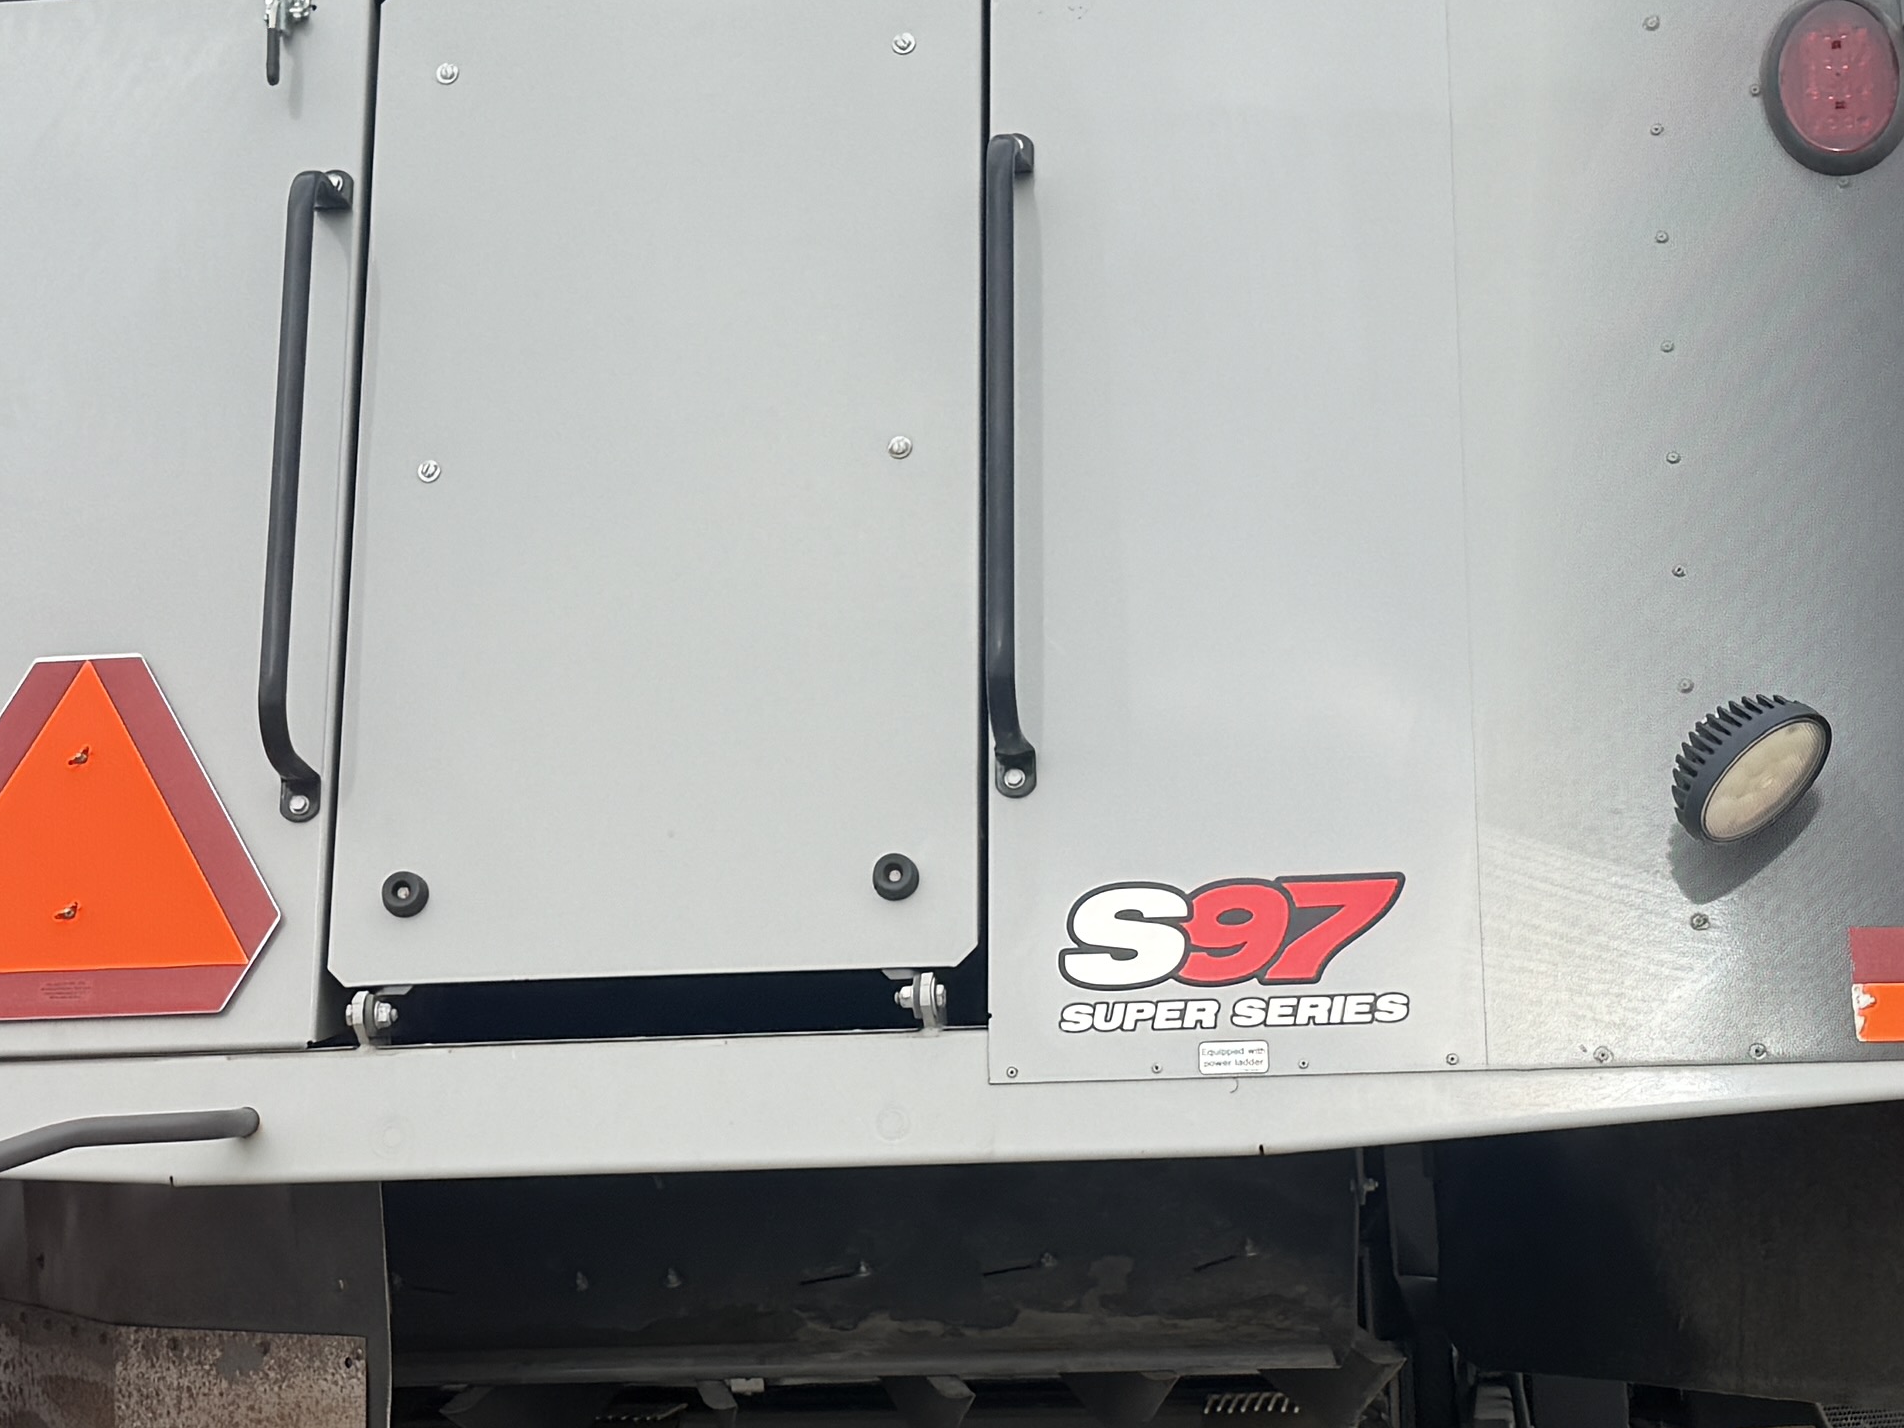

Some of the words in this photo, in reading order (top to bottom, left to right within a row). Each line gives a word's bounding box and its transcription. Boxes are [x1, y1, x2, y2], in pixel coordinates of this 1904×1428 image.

[1058, 872, 1405, 992] S97
[1059, 998, 1220, 1034] SUPER
[1230, 992, 1410, 1028] SERIES
[1201, 1047, 1245, 1057] Equipped
